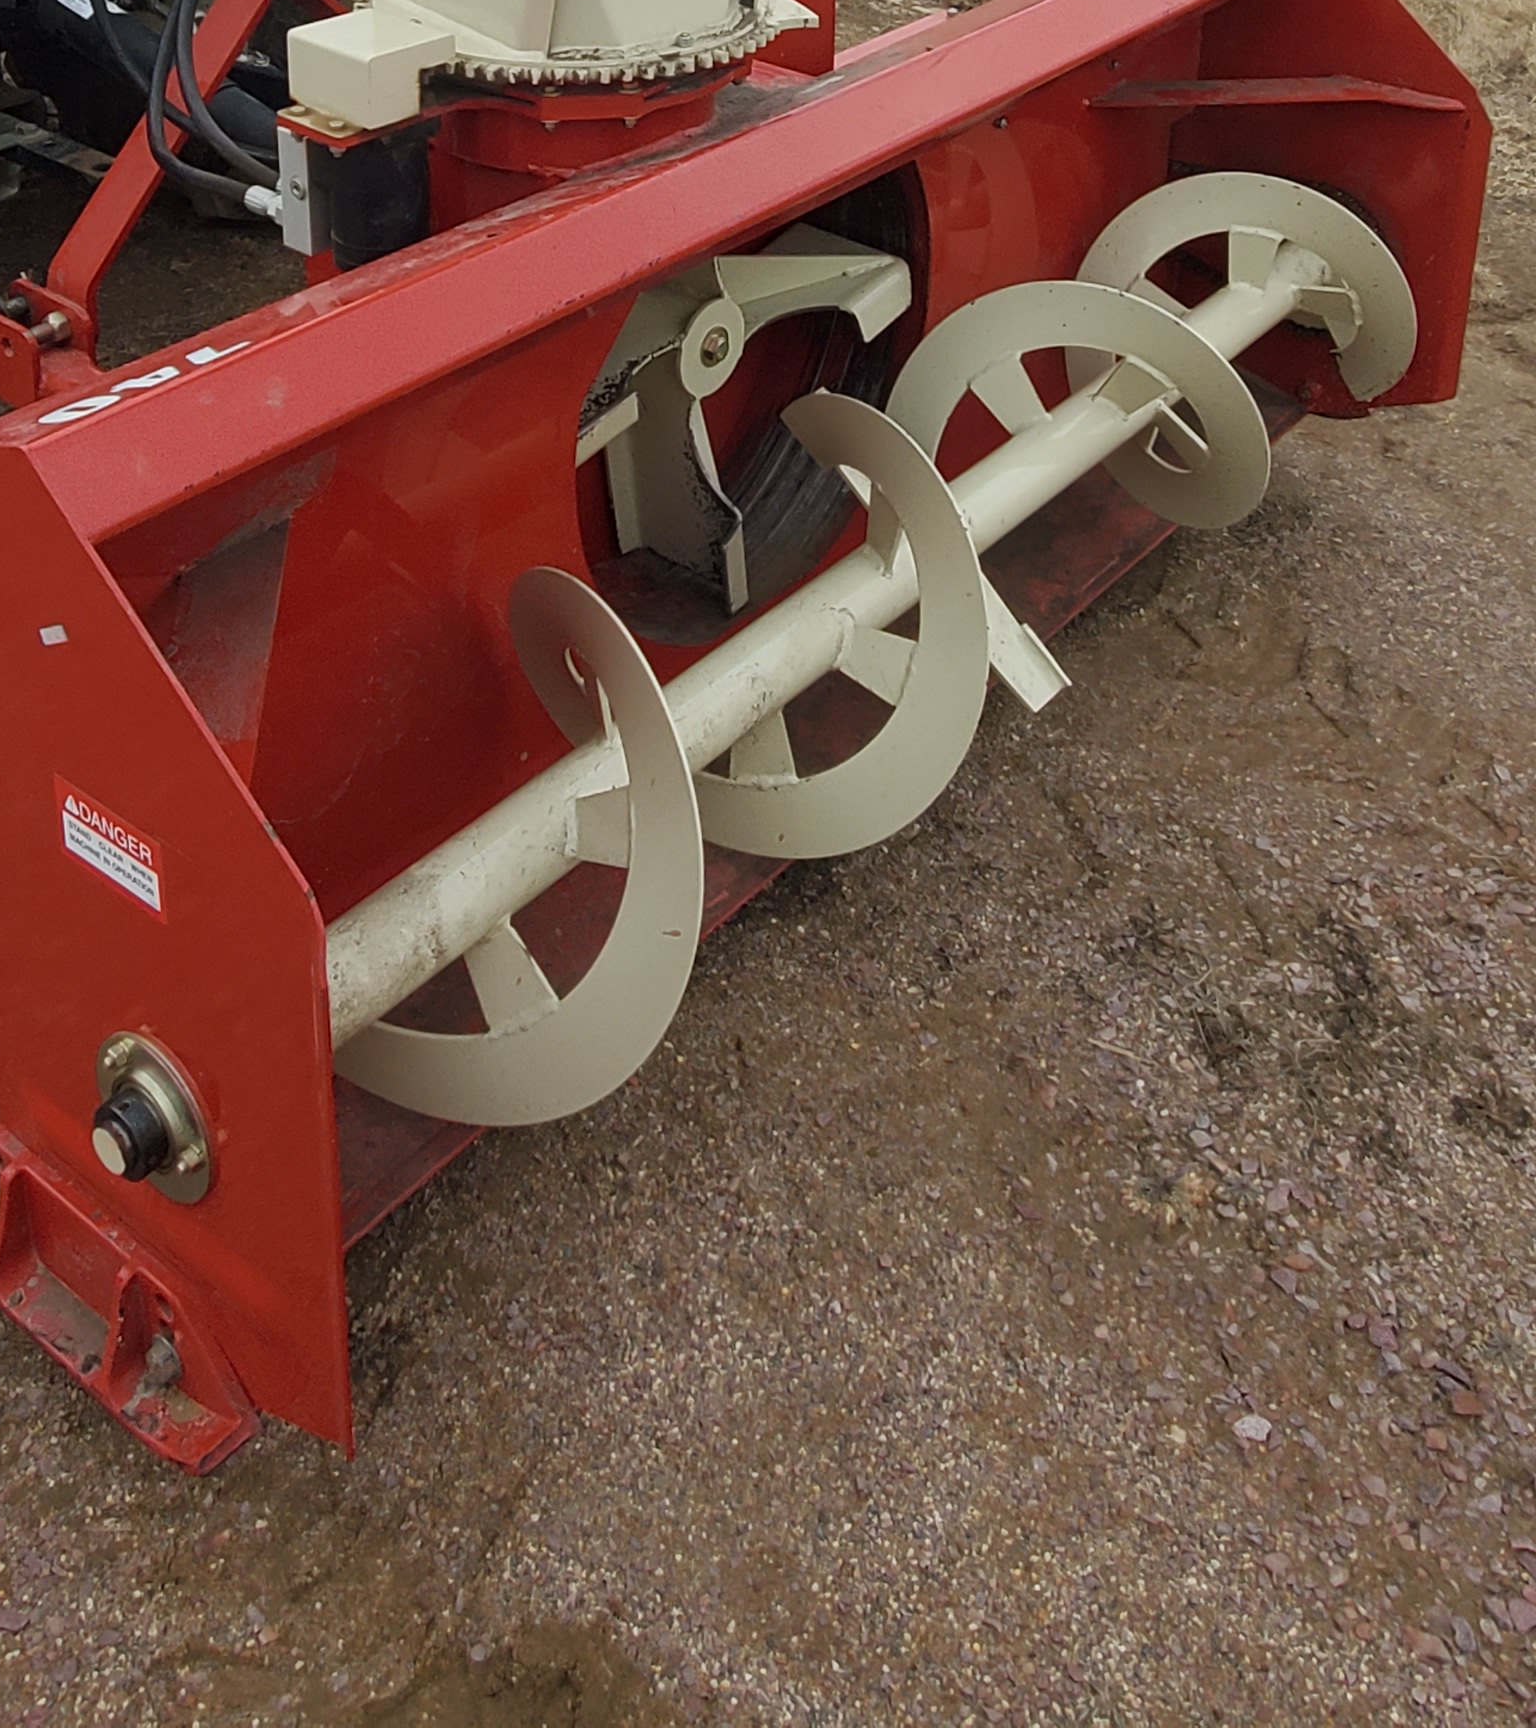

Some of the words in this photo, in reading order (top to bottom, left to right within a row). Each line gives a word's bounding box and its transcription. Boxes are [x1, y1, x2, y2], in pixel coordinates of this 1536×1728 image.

[68, 820, 92, 842] STAND
[98, 841, 124, 863] CLEAR
[130, 862, 154, 883] WHEN
[78, 800, 153, 866] DANGER
[112, 861, 155, 897] OPERATION
